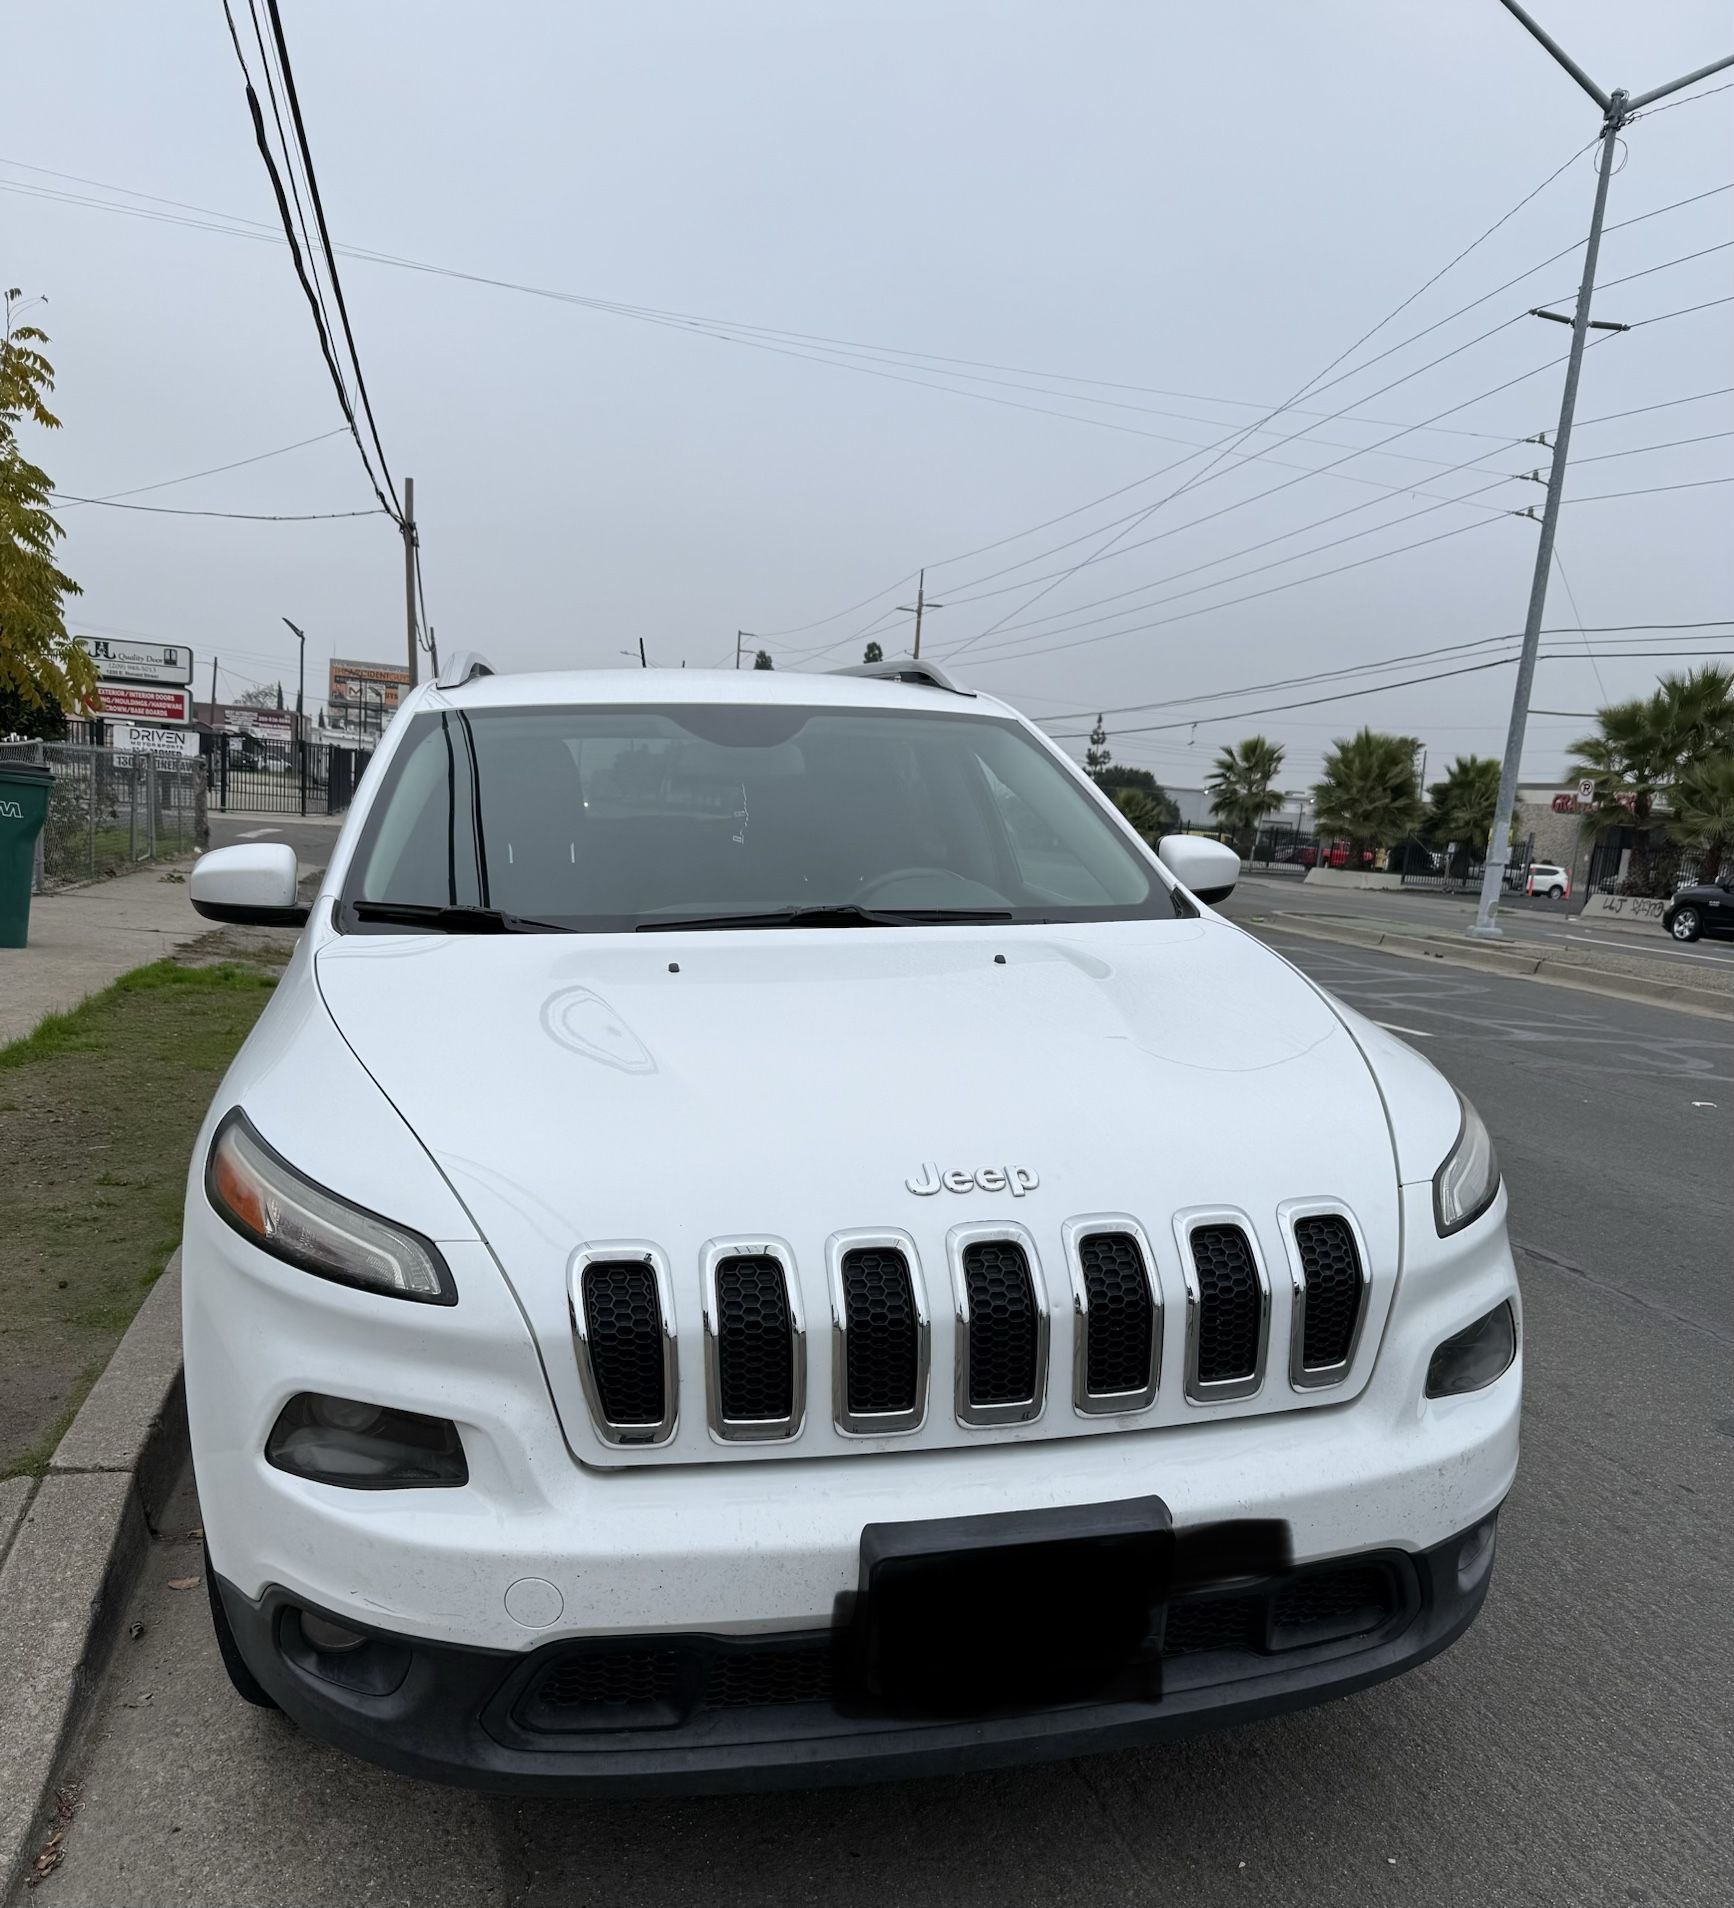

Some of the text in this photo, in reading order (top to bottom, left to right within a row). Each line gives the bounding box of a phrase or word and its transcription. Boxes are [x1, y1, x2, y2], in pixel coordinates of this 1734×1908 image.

[118, 653, 144, 663] Quality
[147, 655, 163, 664] Door
[145, 708, 168, 717] BOARDS
[129, 728, 185, 745] DRIVEN
[905, 1161, 1040, 1198] Jeep
